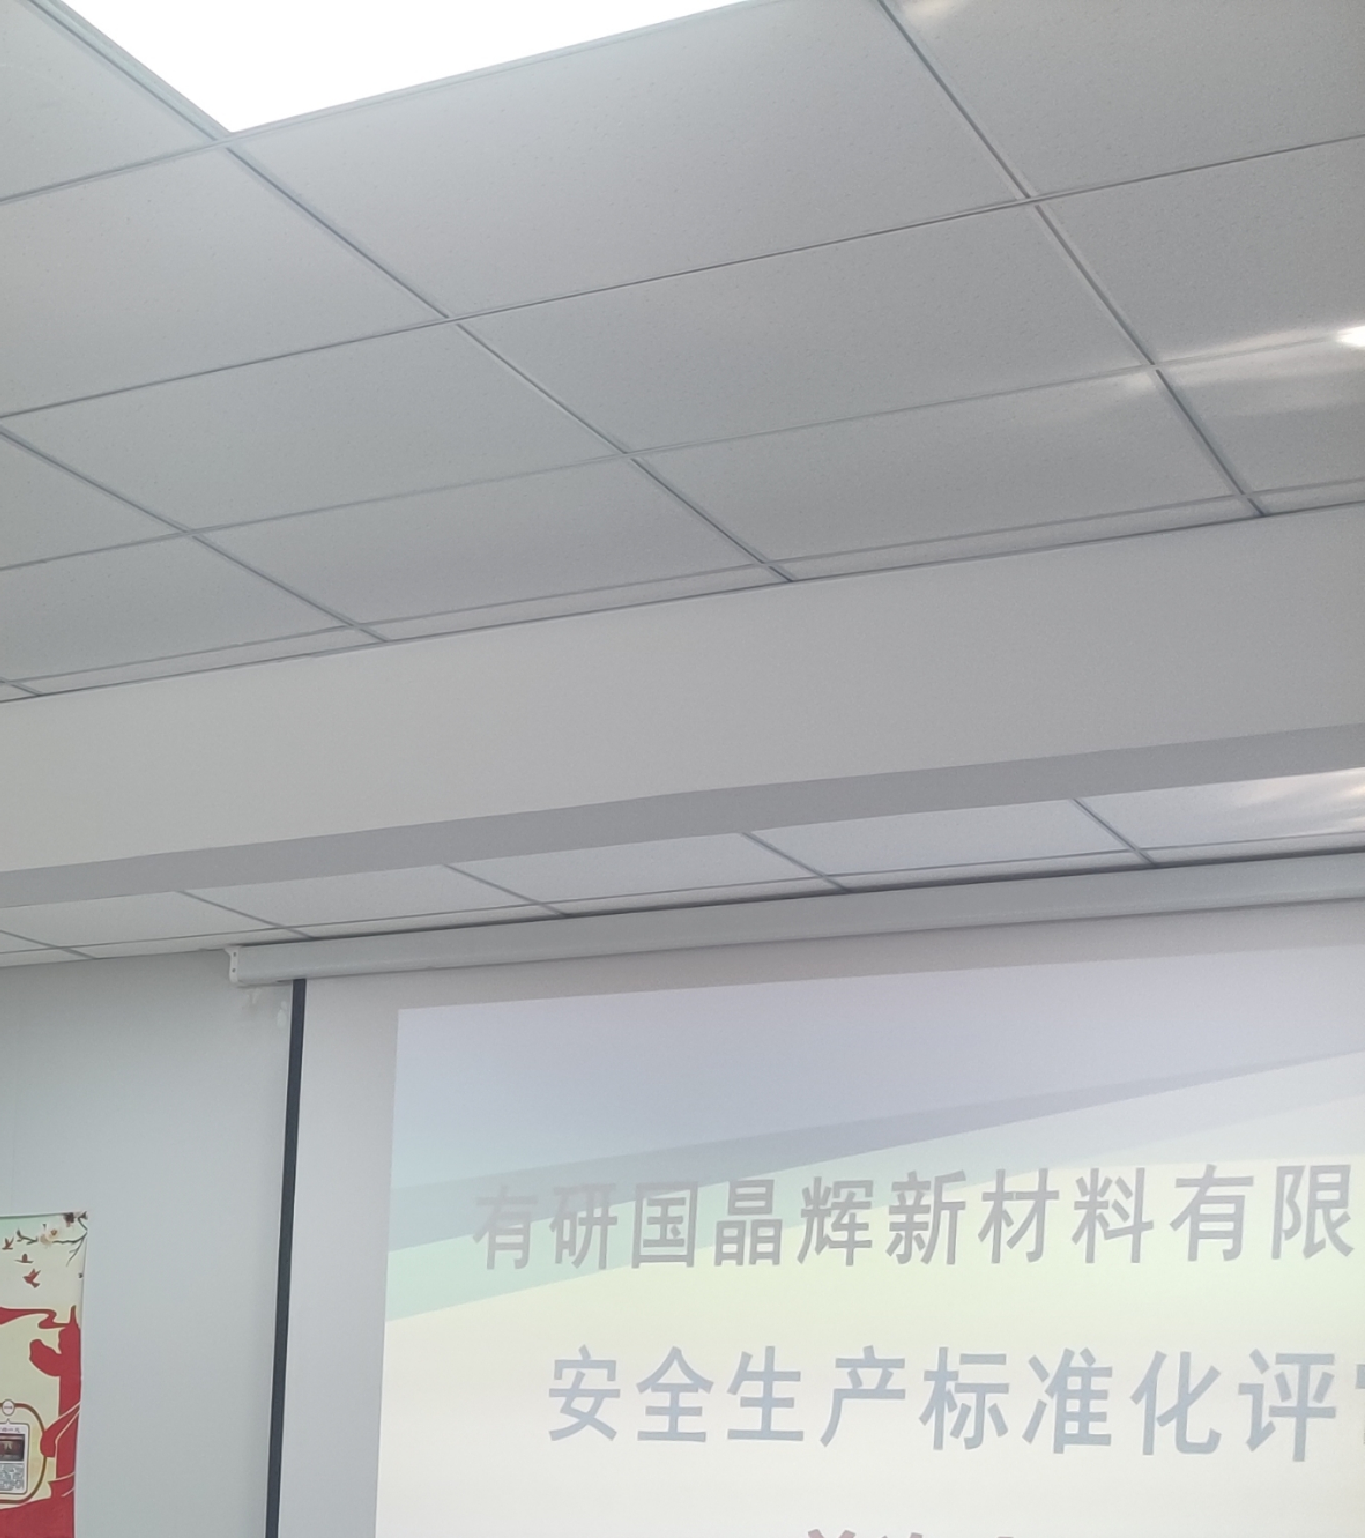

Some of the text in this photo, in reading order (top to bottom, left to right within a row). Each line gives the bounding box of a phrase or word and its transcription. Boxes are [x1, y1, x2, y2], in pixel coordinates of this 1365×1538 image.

[472, 1164, 1355, 1270] 有研国晶辉新材料有限
[547, 1344, 1365, 1463] 安全生产标准化评
